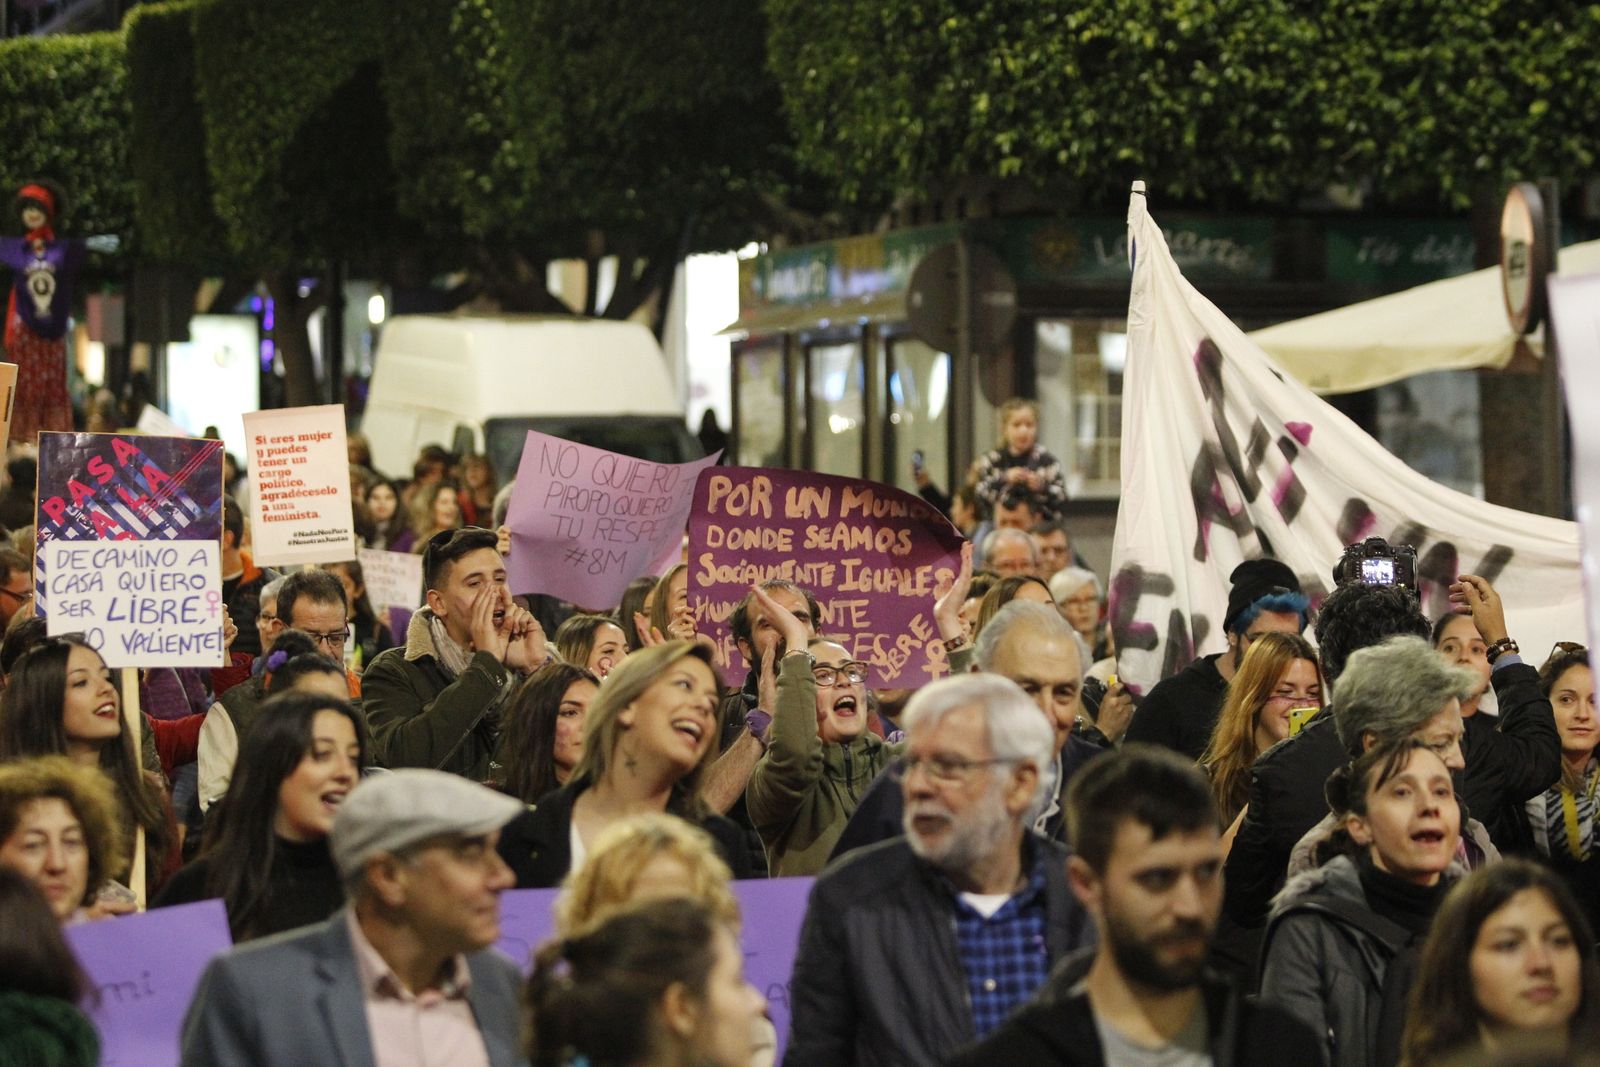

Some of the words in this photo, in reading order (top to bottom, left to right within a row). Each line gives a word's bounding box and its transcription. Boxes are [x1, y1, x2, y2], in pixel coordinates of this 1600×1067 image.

[255, 434, 267, 445] Si
[270, 434, 295, 444] eres
[298, 430, 333, 443] mujer
[256, 448, 264, 458] y
[267, 445, 308, 457] puedes
[257, 458, 288, 467] tener
[291, 456, 307, 464] un
[259, 468, 292, 479] cargo
[539, 441, 580, 479] NO
[591, 453, 681, 494] QUIERO
[41, 437, 142, 527] PASA
[272, 502, 295, 510] una
[543, 480, 611, 516] PIROPO
[707, 475, 773, 519] POR
[784, 486, 831, 519] UN
[550, 513, 584, 539] TU
[706, 524, 795, 552] DONDE
[803, 521, 913, 556] SEAMOS
[92, 544, 178, 569] CAMINO
[187, 548, 208, 567] A
[563, 547, 628, 575] #8M
[52, 571, 103, 594] CASA
[118, 569, 206, 593] QUIERO
[58, 599, 95, 617] SER
[121, 626, 222, 659] VALIENTE!
